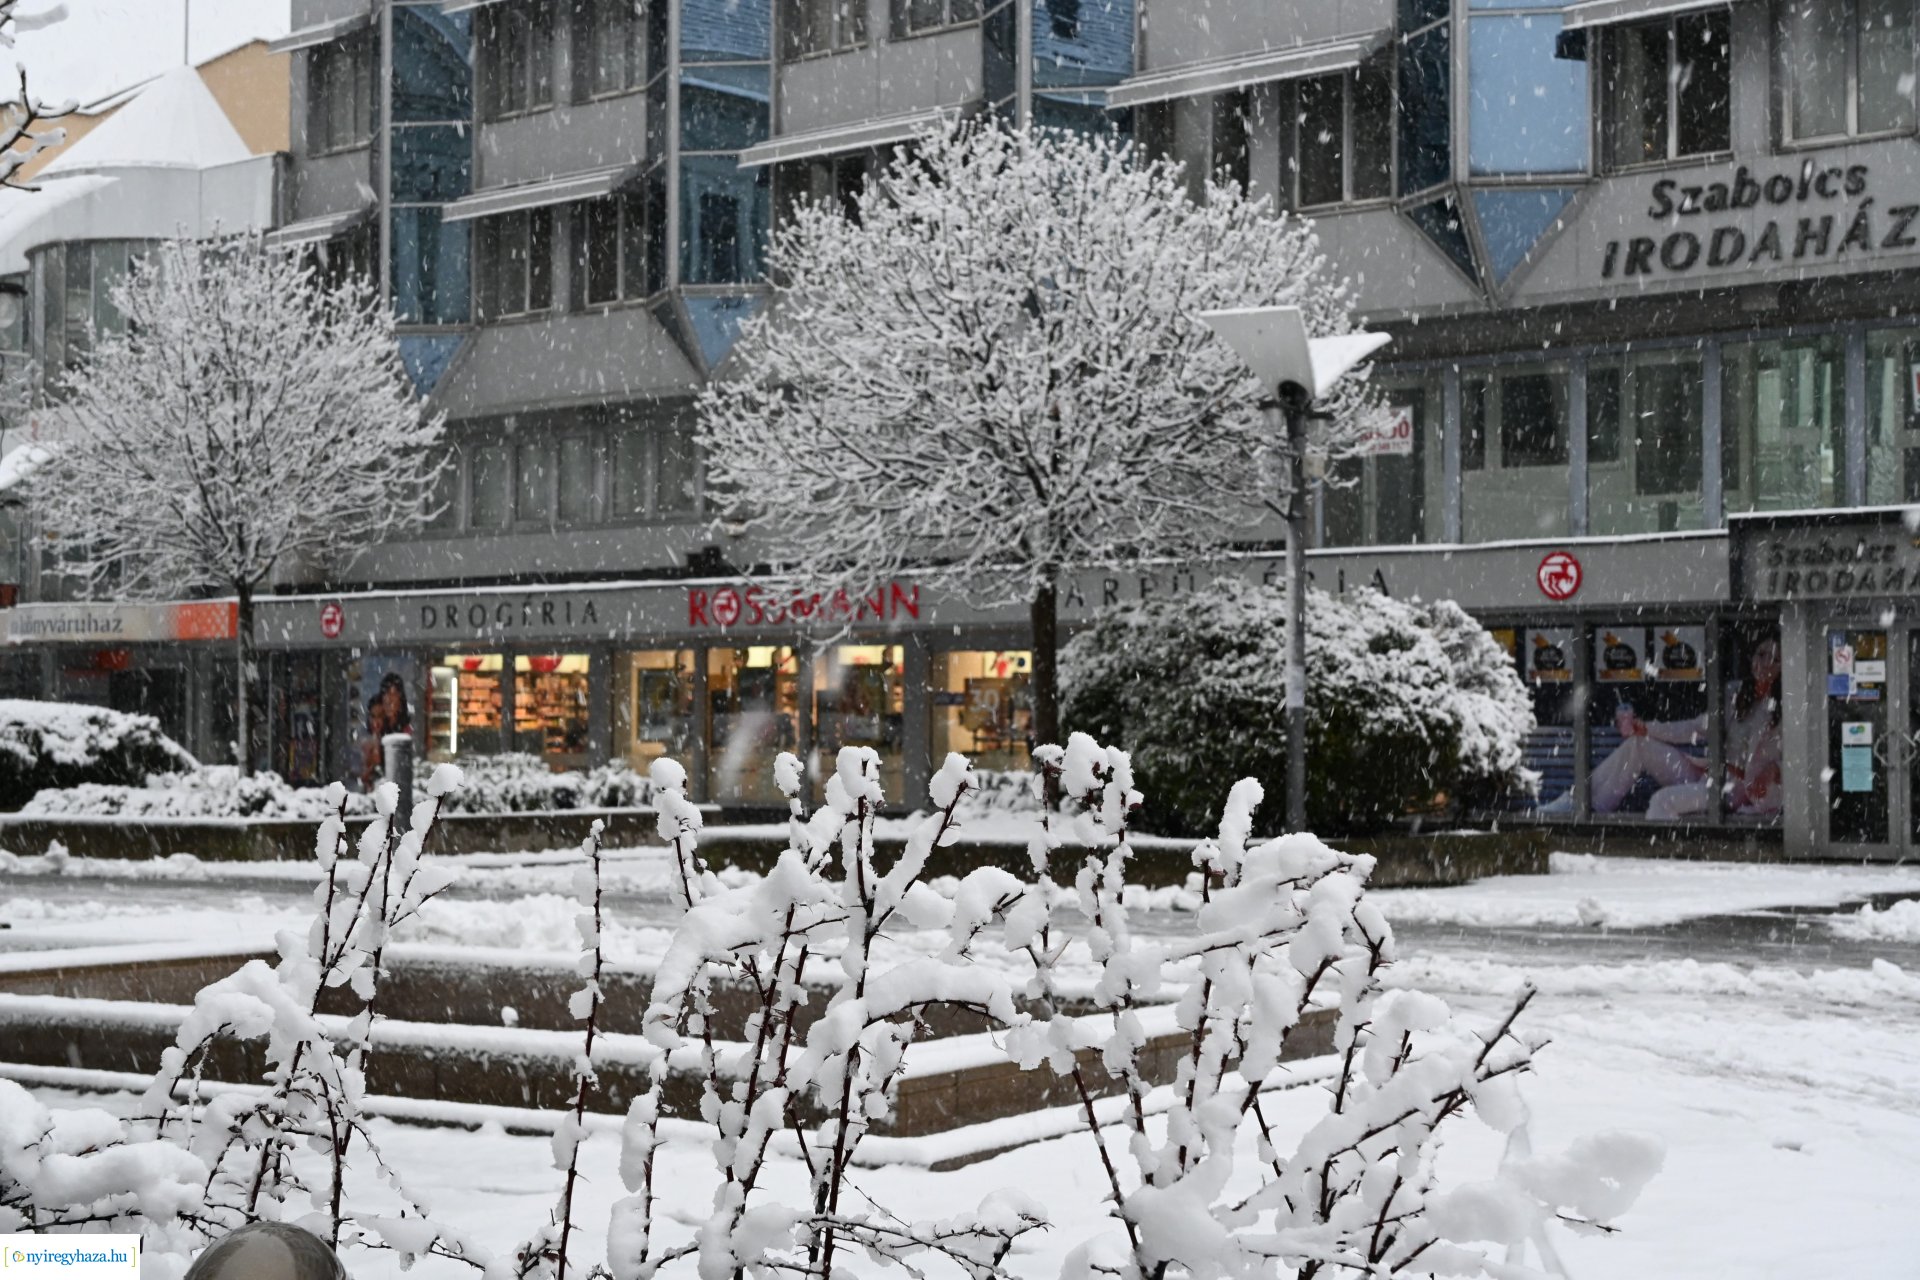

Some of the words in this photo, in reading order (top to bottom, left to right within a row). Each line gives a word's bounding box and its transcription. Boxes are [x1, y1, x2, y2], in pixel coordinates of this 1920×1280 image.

[1649, 157, 1868, 219] Szabolcs
[1601, 197, 1920, 278] IRODAHÁZ
[421, 595, 599, 629] DROGÉRIA
